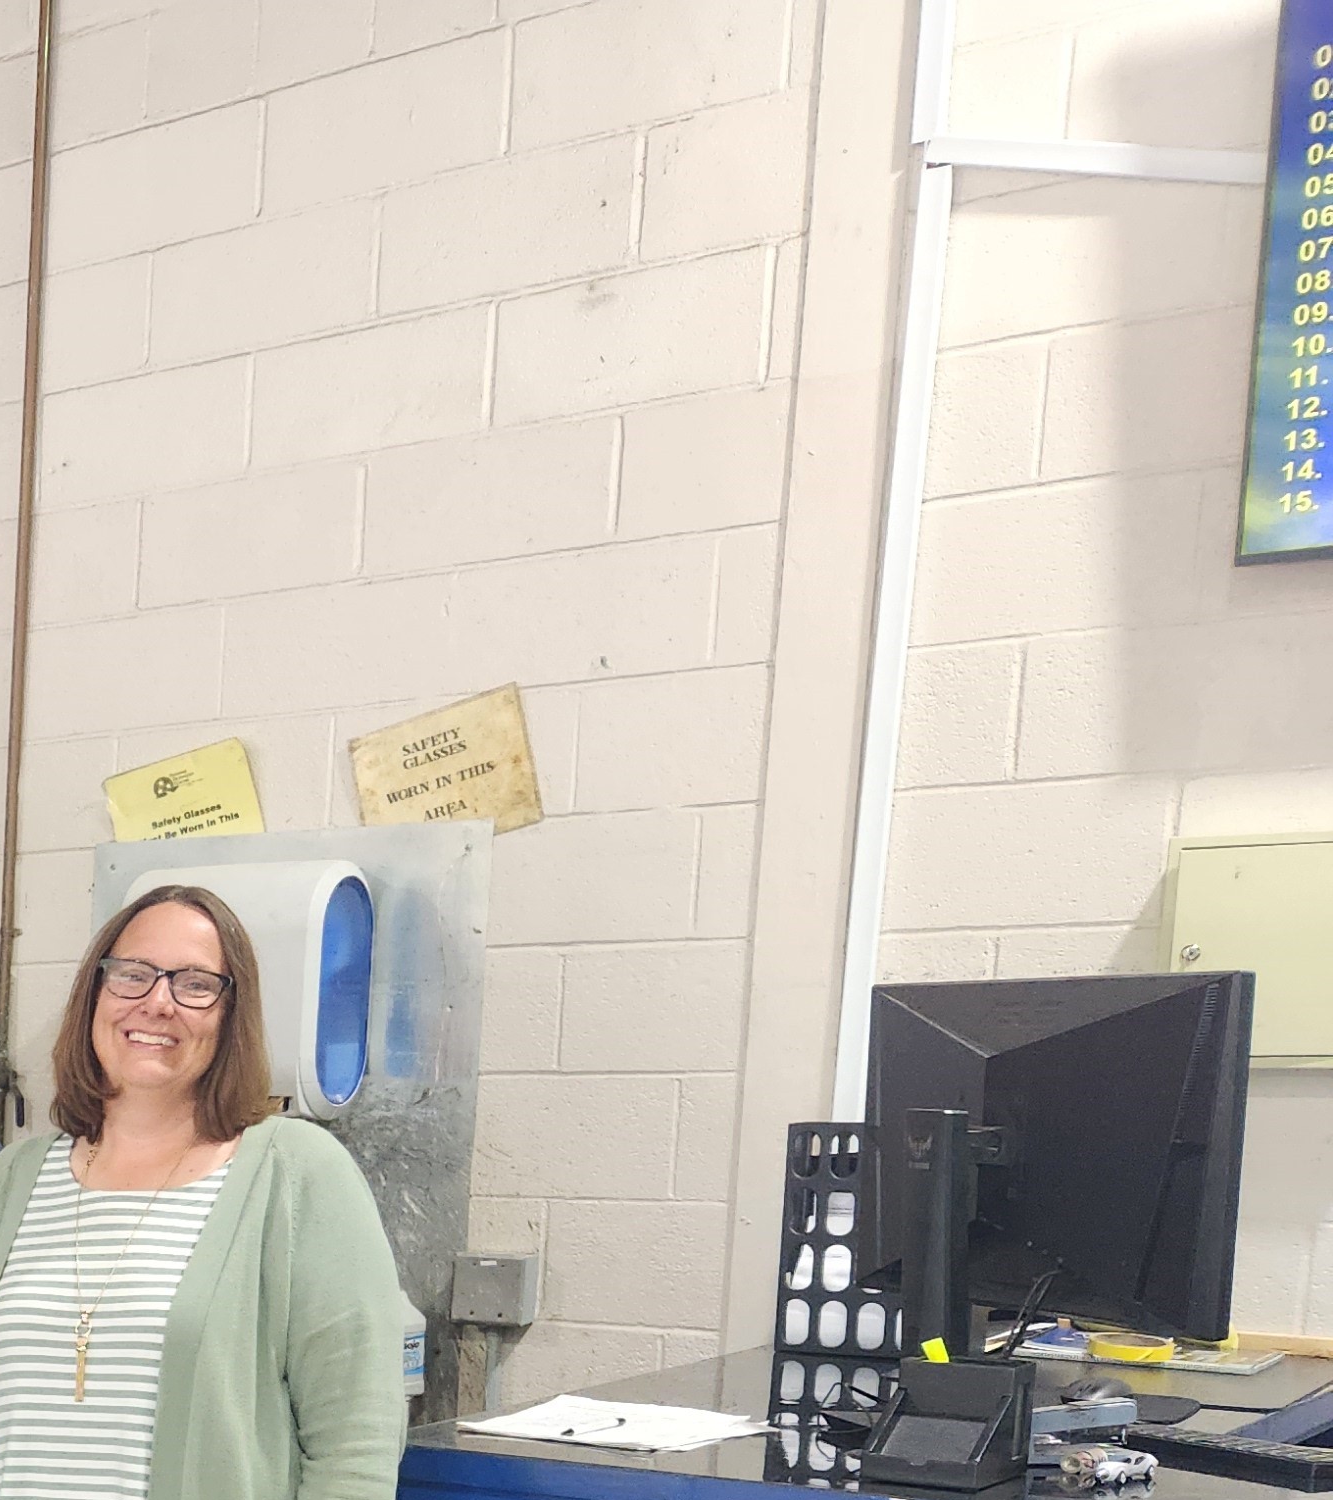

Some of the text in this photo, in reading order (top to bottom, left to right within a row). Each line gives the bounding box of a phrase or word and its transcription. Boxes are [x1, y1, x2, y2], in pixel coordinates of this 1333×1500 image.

[1292, 333, 1333, 358] 10.
[1289, 364, 1329, 389] 11.
[1286, 396, 1328, 420] 12.
[1283, 428, 1325, 451] 13.
[1281, 458, 1323, 483] 14.
[1279, 490, 1320, 514] 15.
[402, 727, 461, 757] SAFETY
[403, 739, 468, 771] GLASSES
[386, 760, 497, 804] WORN IN THIS
[151, 803, 222, 830] Safety Glasses
[424, 799, 468, 823] AREA
[164, 831, 177, 840] Be
[180, 823, 204, 836] Worn
[207, 819, 216, 828] In
[218, 811, 240, 825] This
